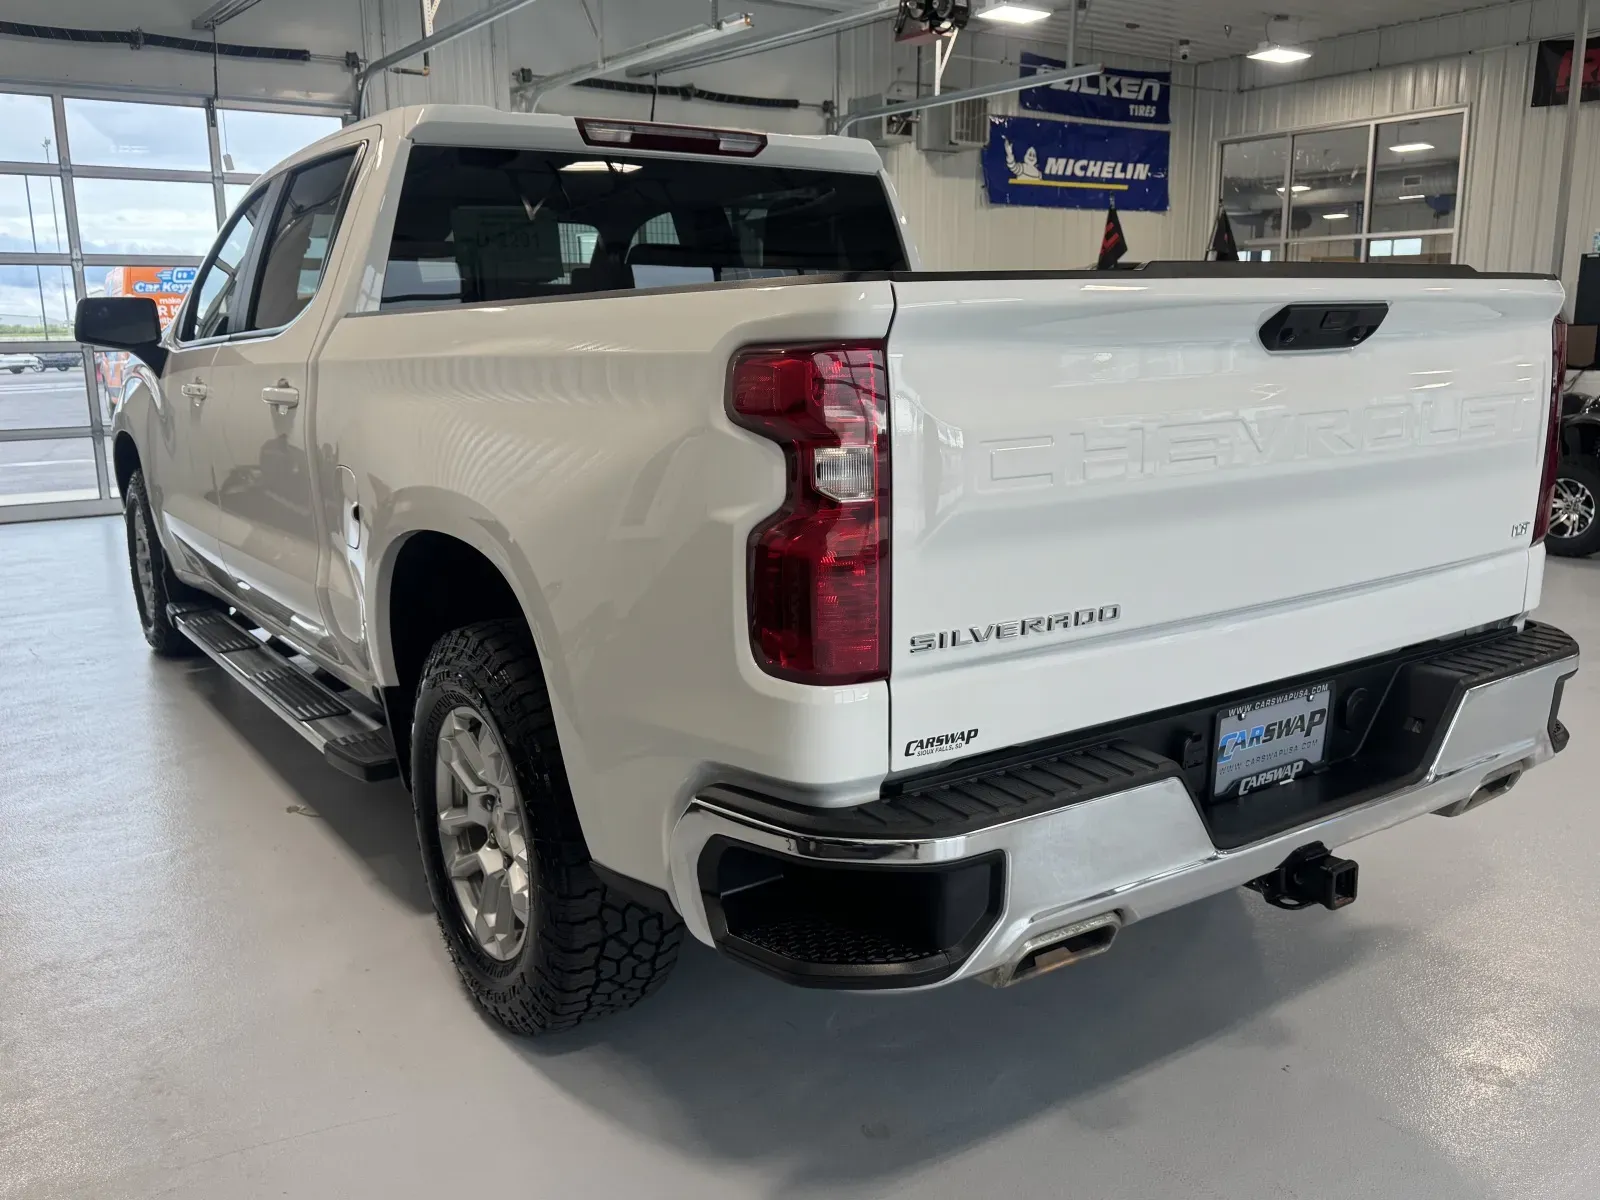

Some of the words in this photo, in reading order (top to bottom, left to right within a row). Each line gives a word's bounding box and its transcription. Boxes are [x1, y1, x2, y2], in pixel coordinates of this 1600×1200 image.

[1129, 104, 1156, 117] TIRES
[1045, 157, 1149, 180] MICHELIN
[134, 281, 160, 293] Car
[977, 391, 1535, 493] CHEVROLET
[909, 603, 1121, 653] SILVERADO
[1228, 683, 1329, 717] WWW.CARSWAPUSA.COM
[904, 728, 979, 757] CARSWAP
[916, 748, 934, 757] SIOUX
[935, 744, 954, 752] FALLS,
[1217, 708, 1327, 764] CARSWAP
[1238, 760, 1304, 795] CARSWAP
